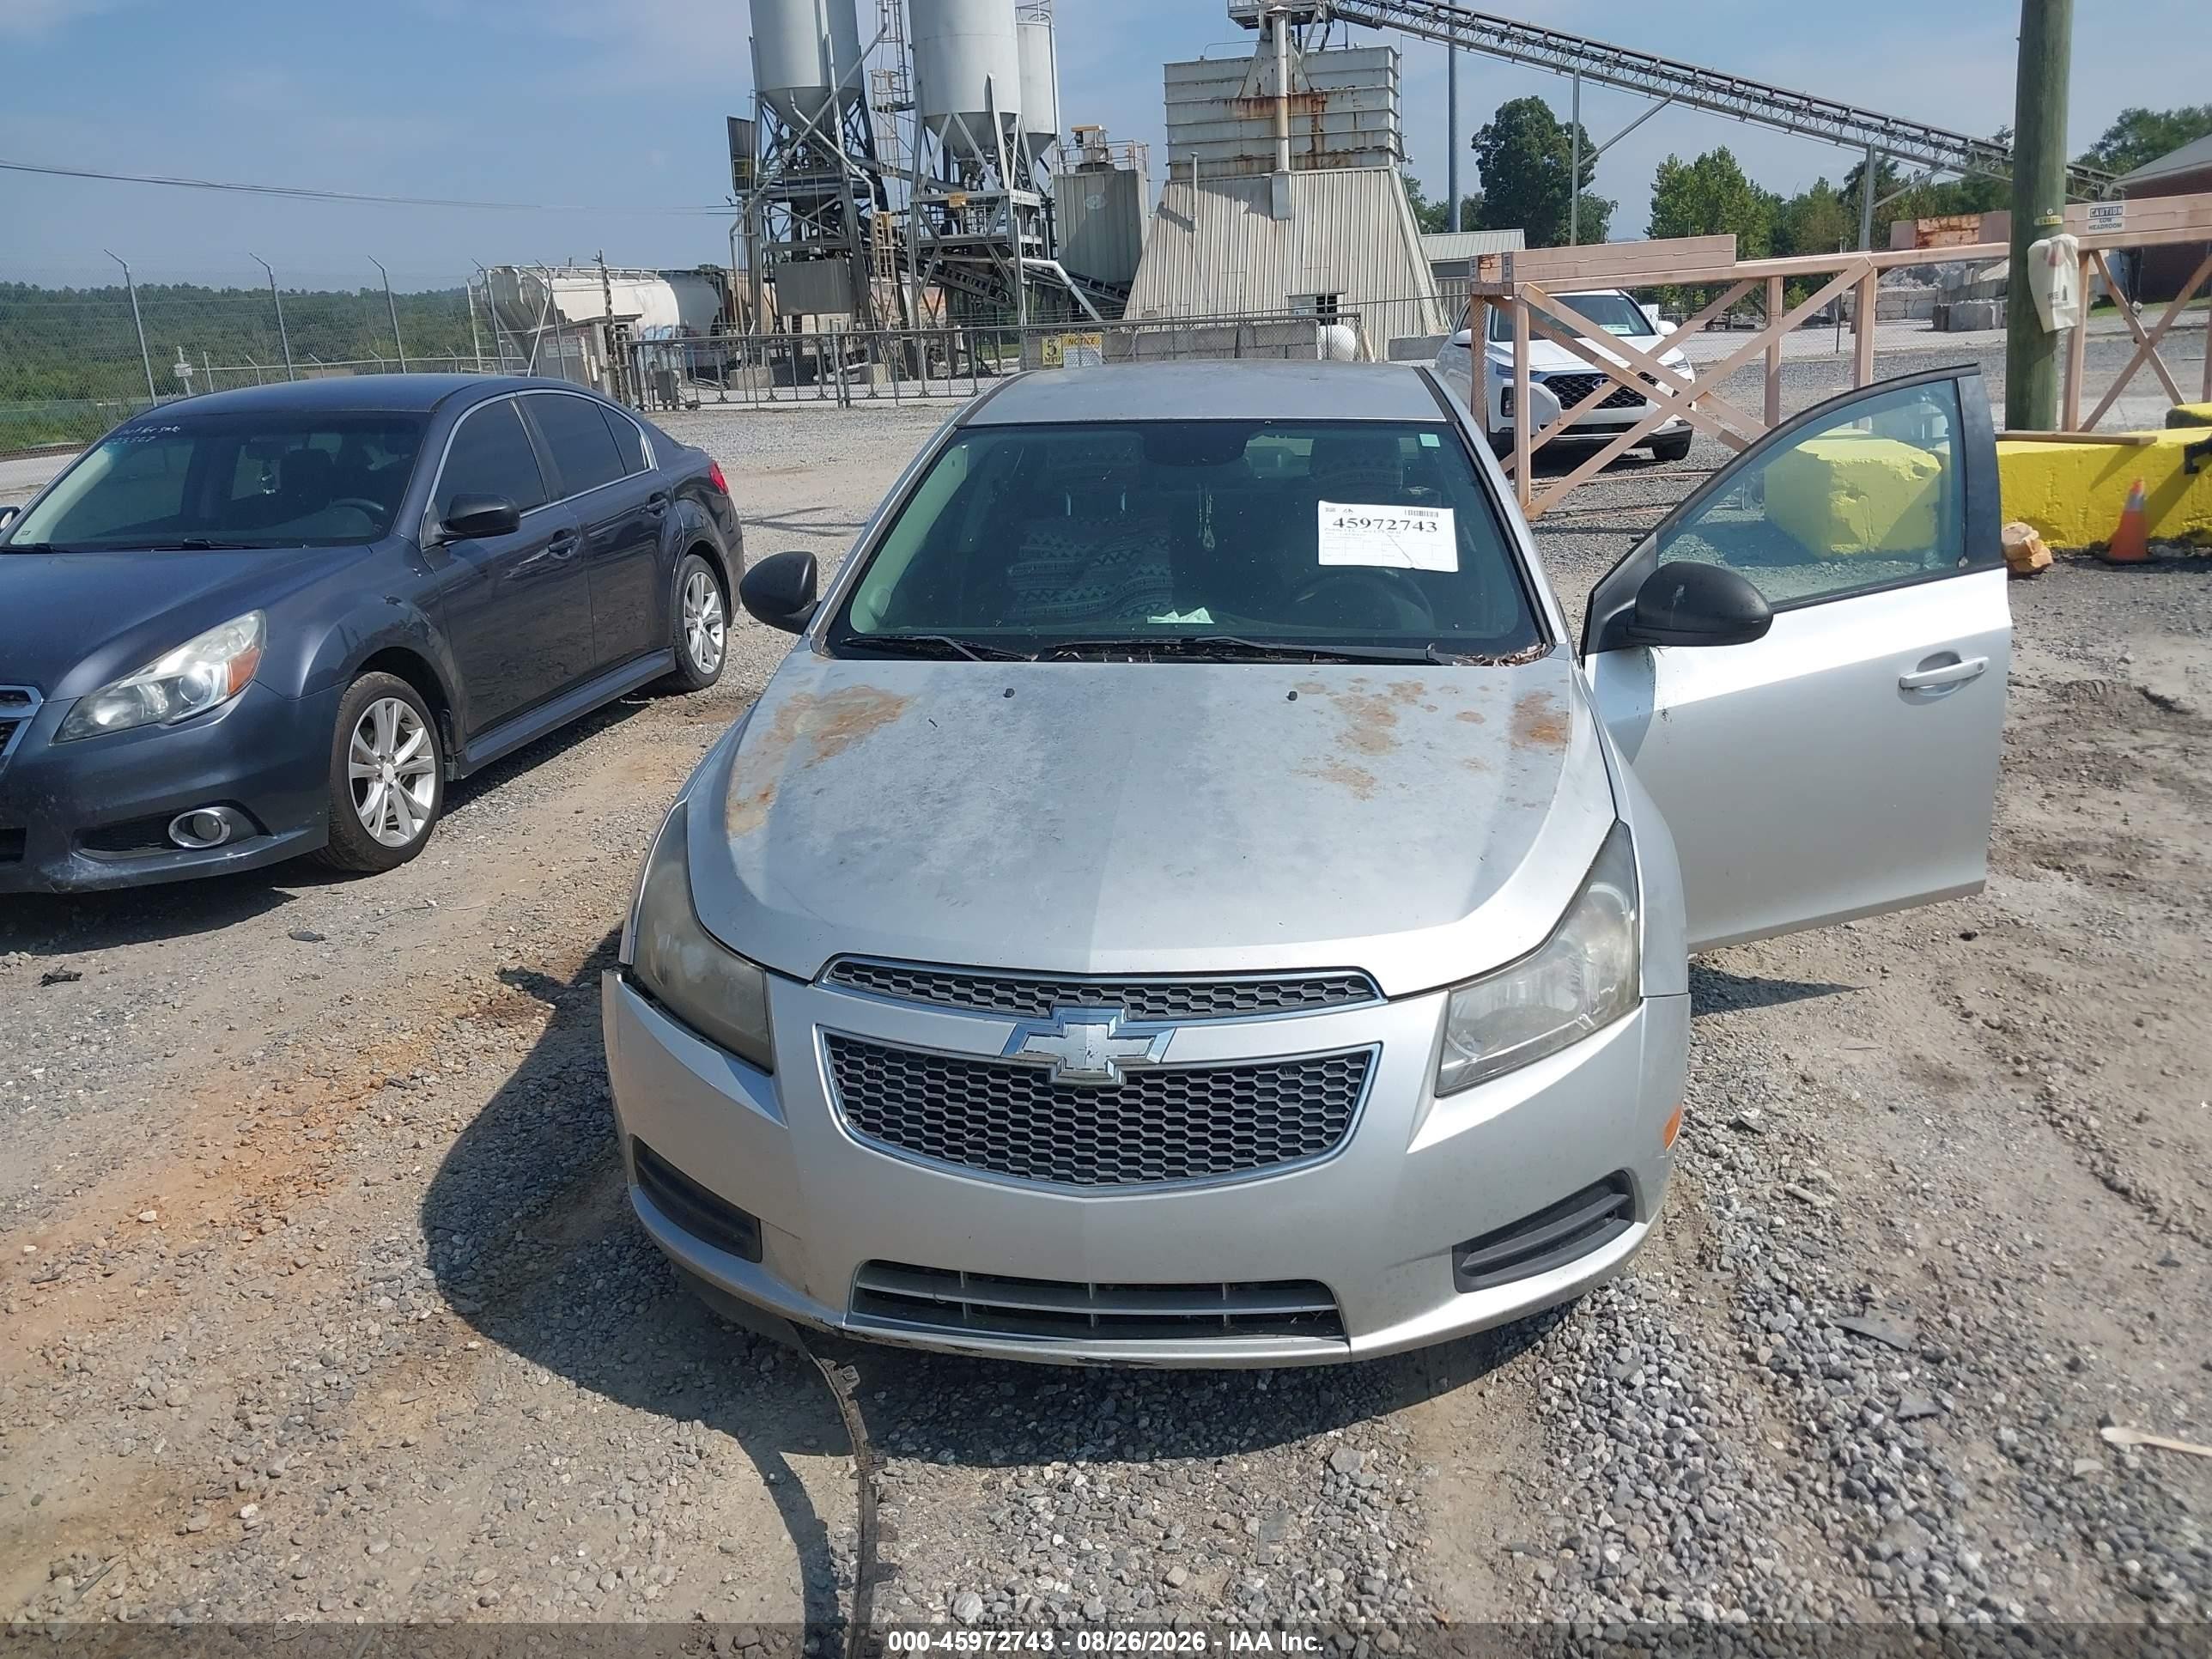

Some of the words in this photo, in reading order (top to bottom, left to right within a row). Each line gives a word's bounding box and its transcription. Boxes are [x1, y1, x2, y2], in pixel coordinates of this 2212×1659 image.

[2090, 207, 2123, 216] CAUTION
[1048, 338, 1057, 356] 5
[1068, 337, 1096, 345] NOTICE
[1332, 517, 1438, 533] 45972743
